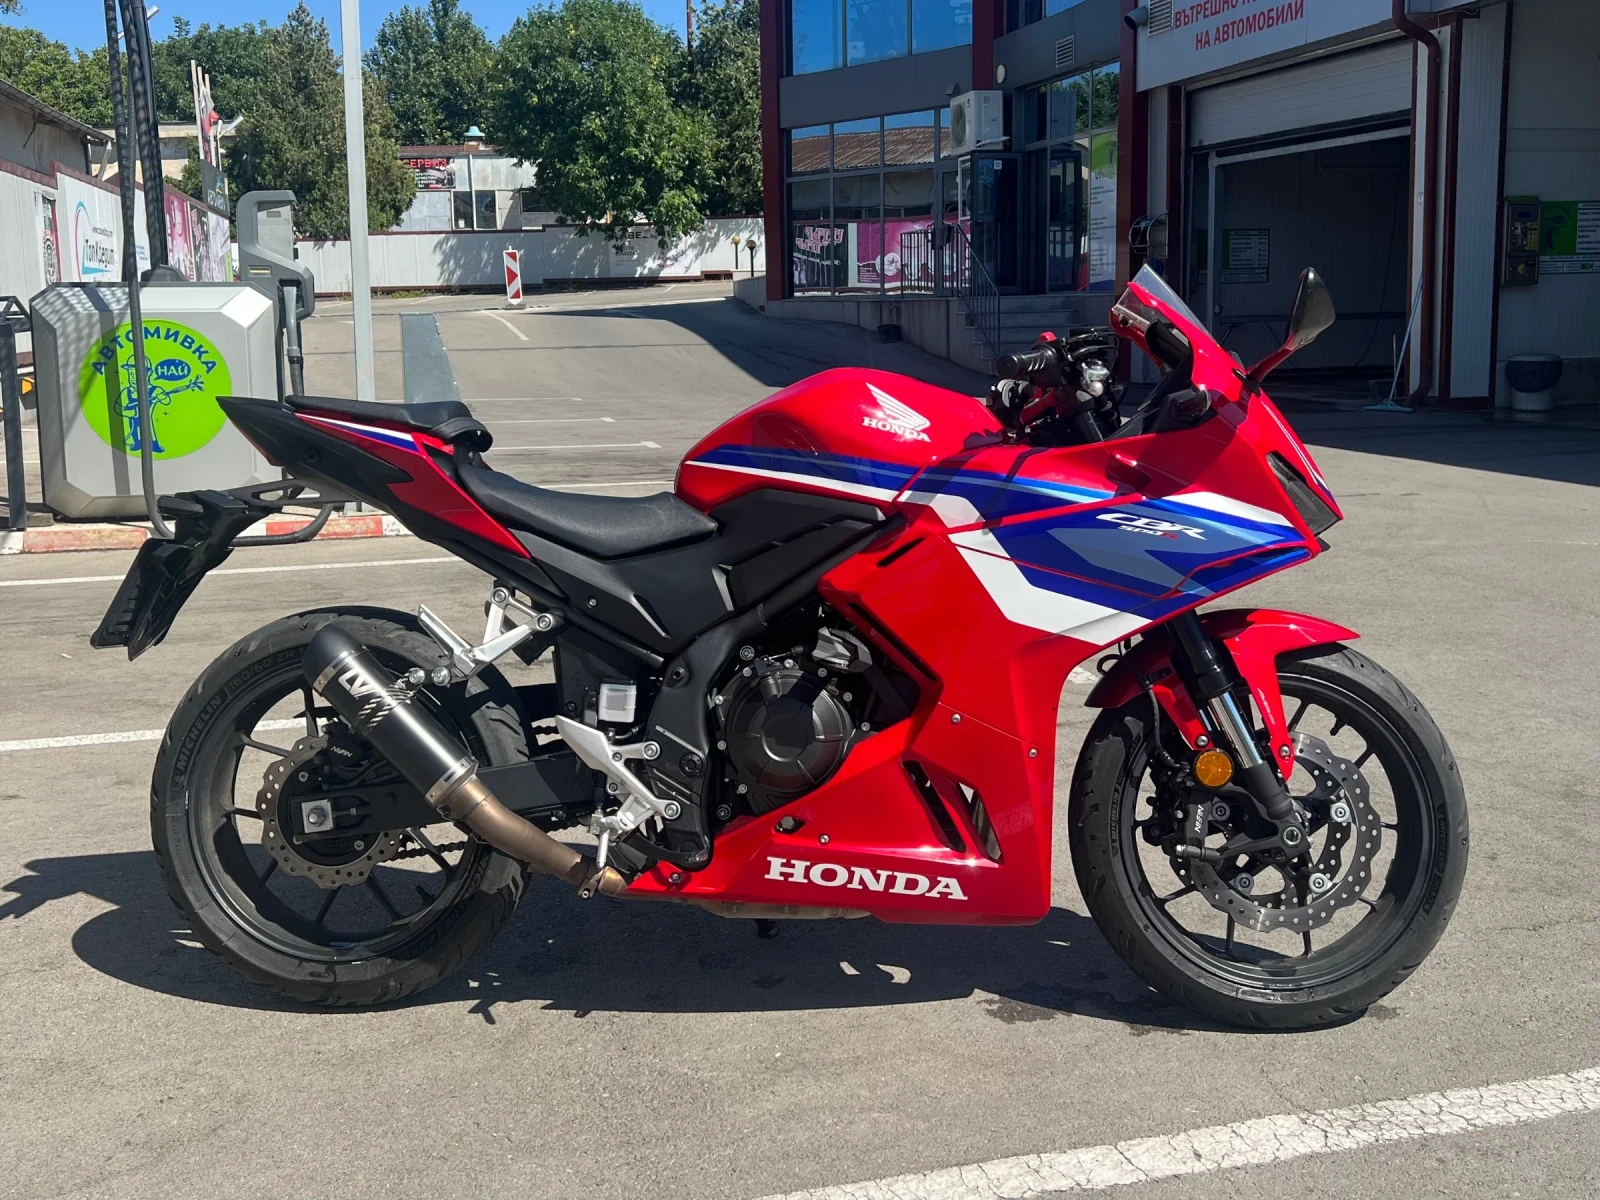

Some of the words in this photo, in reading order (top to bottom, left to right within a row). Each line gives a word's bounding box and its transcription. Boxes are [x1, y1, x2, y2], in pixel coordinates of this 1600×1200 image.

[1174, 0, 1239, 29] ВЪТРЕШНО
[1195, 30, 1211, 51] НА
[1213, 0, 1304, 46] АВТОМОБИЛИ
[407, 158, 447, 169] ЕРВИЗ
[91, 326, 217, 376] АВТОМИВКА
[157, 361, 188, 376] НАЙ
[862, 416, 932, 442] HONDA
[1096, 513, 1208, 540] CBR
[177, 695, 223, 773] MICHELIN
[229, 658, 273, 692] 160/60
[276, 650, 295, 662] ZR
[764, 856, 969, 901] HONDA
